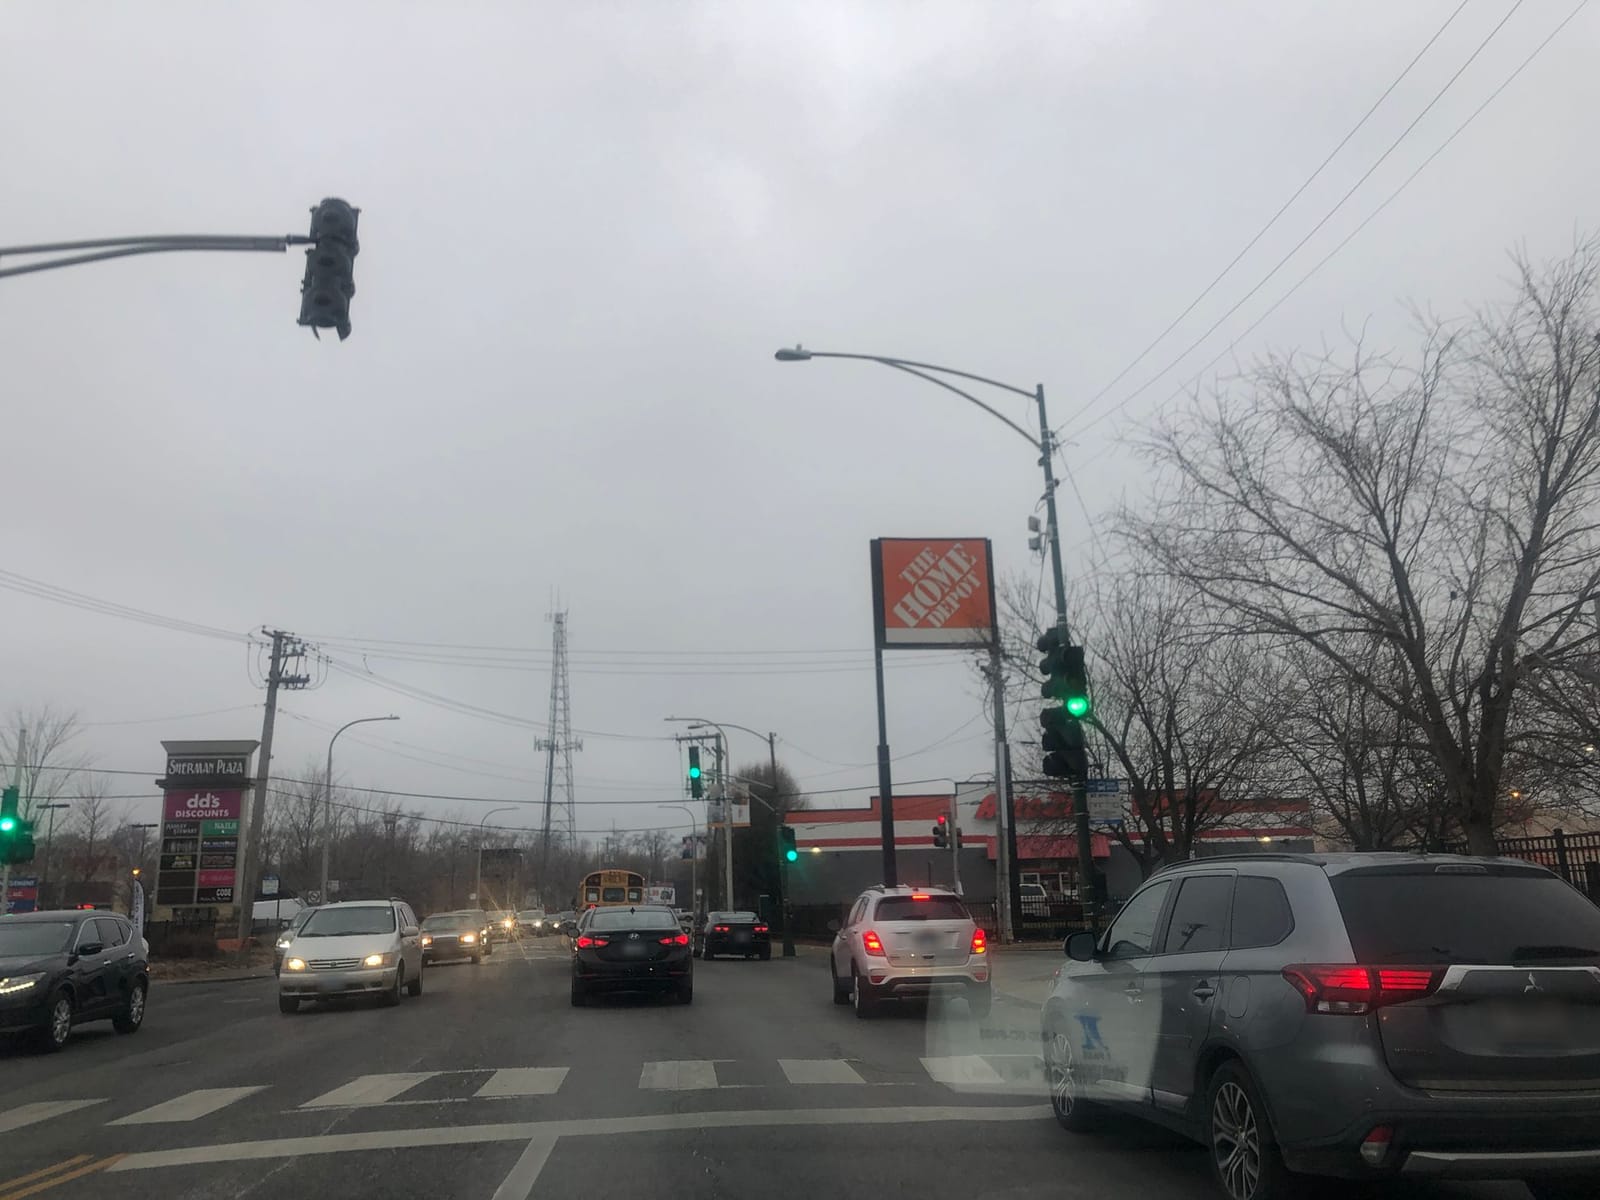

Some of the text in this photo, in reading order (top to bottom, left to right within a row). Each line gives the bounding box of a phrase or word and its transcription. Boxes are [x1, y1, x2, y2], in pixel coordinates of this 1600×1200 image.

[899, 546, 939, 585] THE
[893, 543, 977, 628] HOME
[927, 569, 981, 628] DEPOT
[168, 759, 243, 775] SHERMAN PLAZA
[175, 809, 229, 818] DISCOUNTS
[186, 793, 220, 808] dd's
